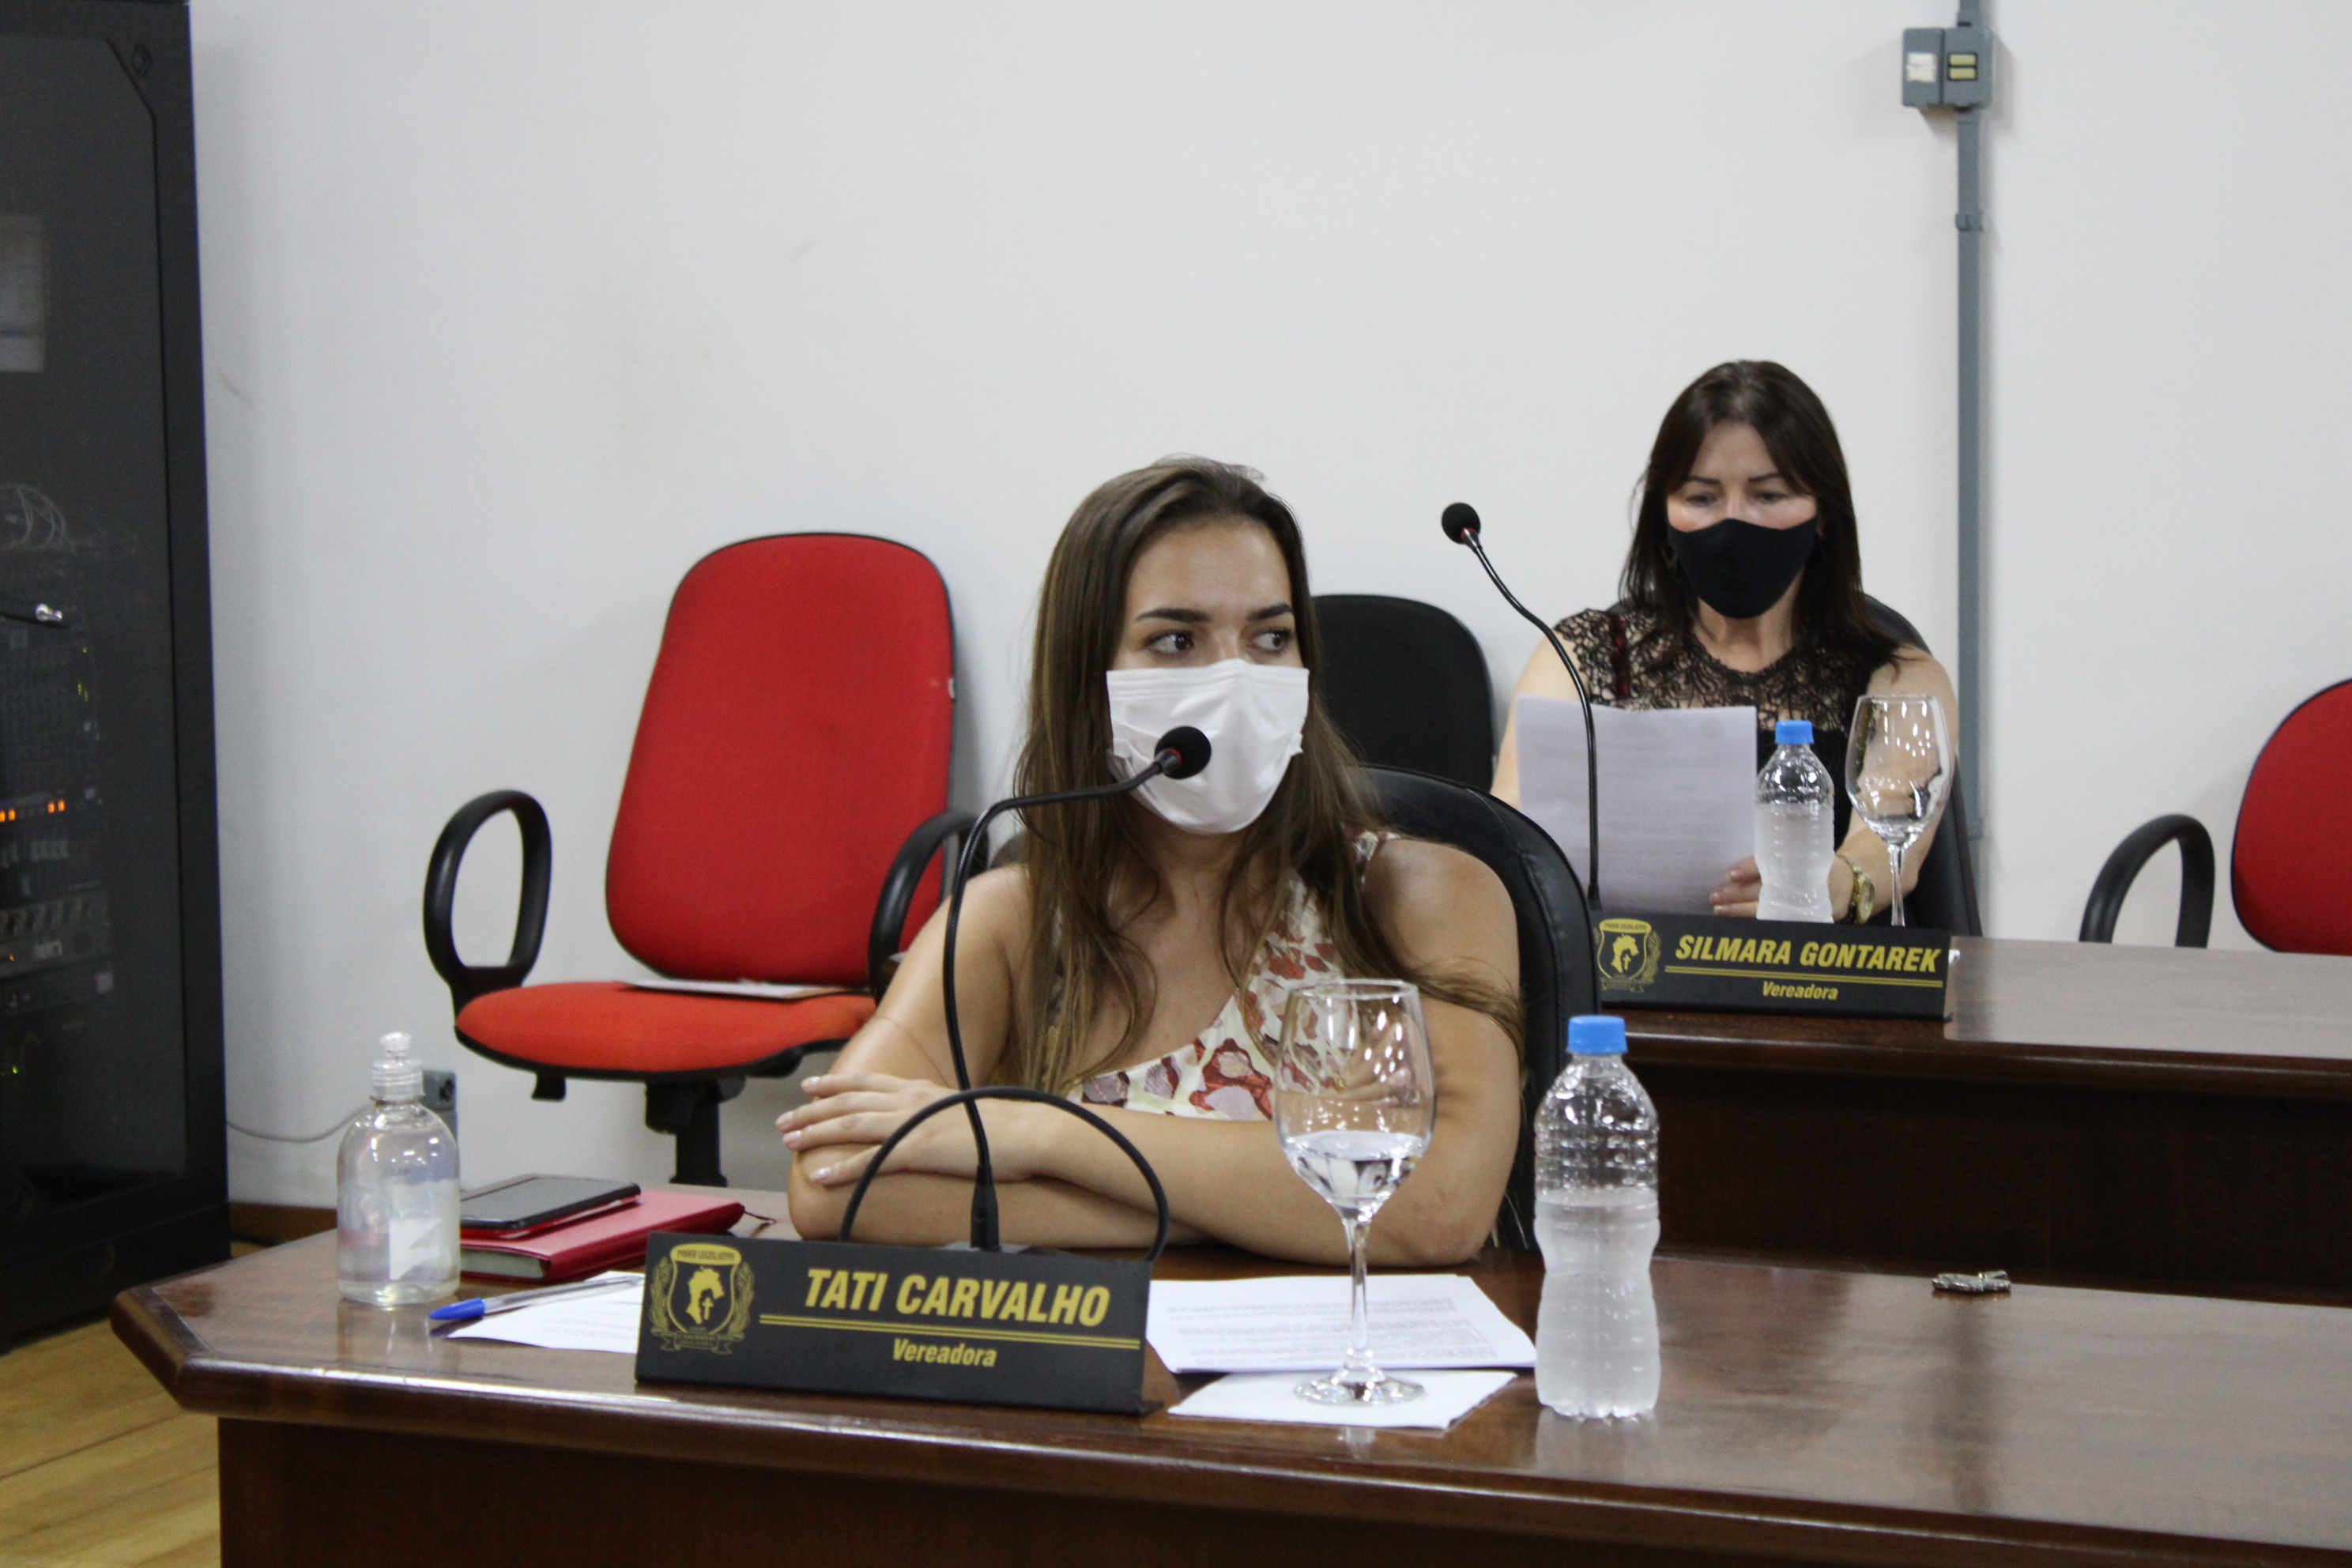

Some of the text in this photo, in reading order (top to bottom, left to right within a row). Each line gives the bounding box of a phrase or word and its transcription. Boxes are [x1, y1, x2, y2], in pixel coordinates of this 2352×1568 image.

[1675, 935, 1942, 972] SILMARA GONTAREK
[1762, 981, 1838, 1000] Vereadora
[806, 1268, 1110, 1327] TATI CARVALHO
[893, 1338, 997, 1367] Vereadora
